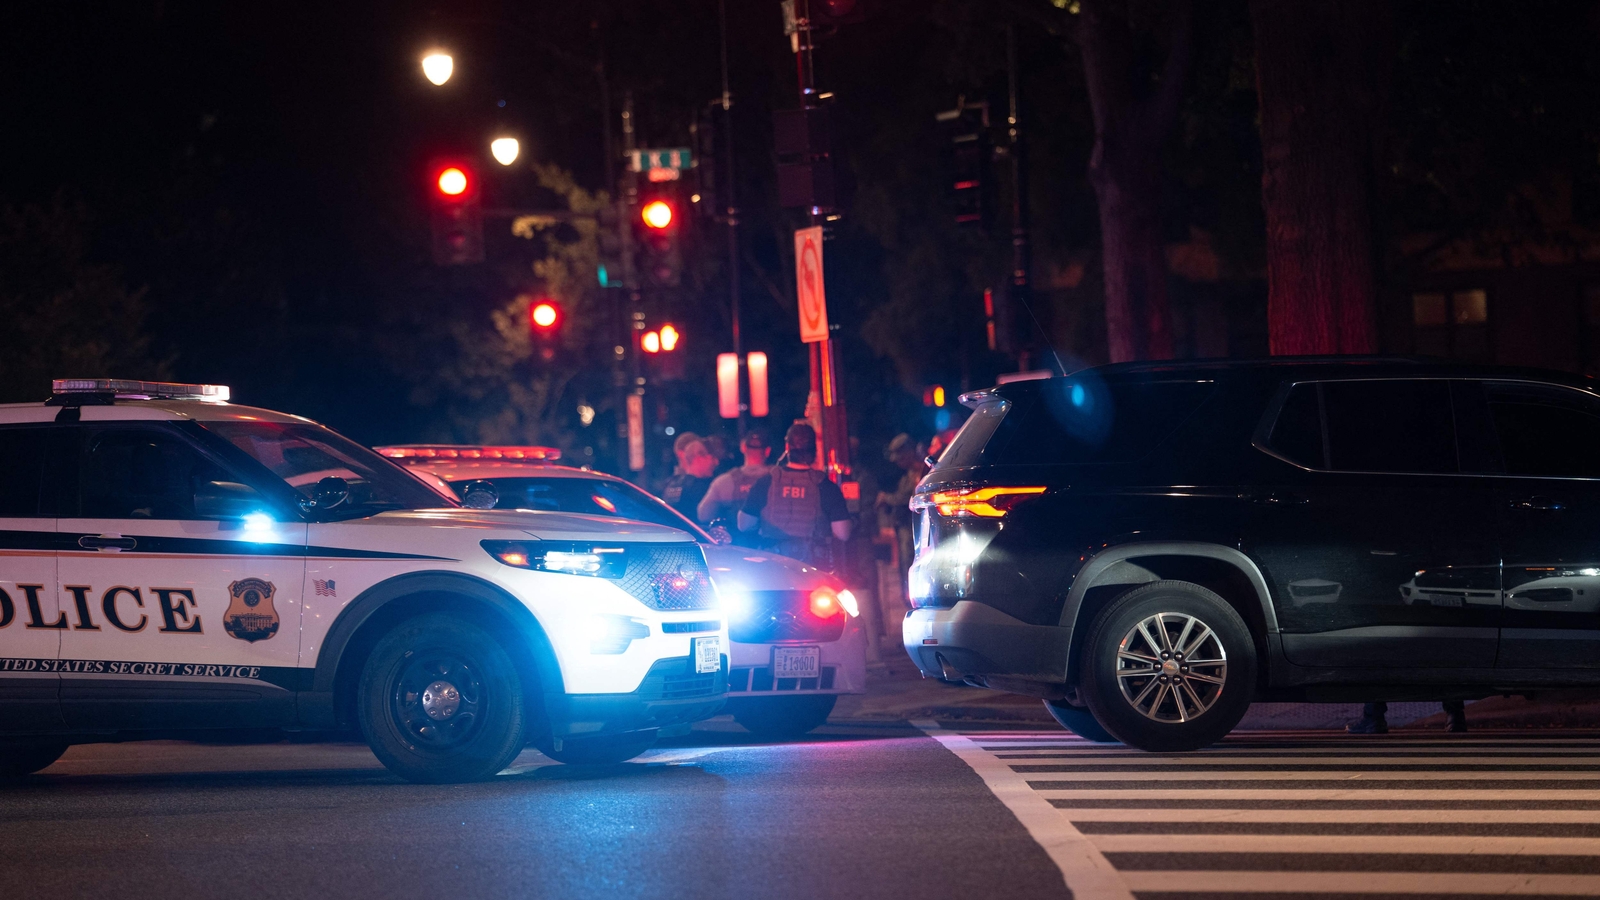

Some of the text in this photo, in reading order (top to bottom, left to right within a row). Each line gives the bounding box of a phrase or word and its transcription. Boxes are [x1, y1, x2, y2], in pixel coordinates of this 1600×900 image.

[782, 486, 805, 499] FBI
[40, 659, 104, 673] STATES
[108, 662, 181, 675] SECRET
[182, 664, 261, 679] SERVICE
